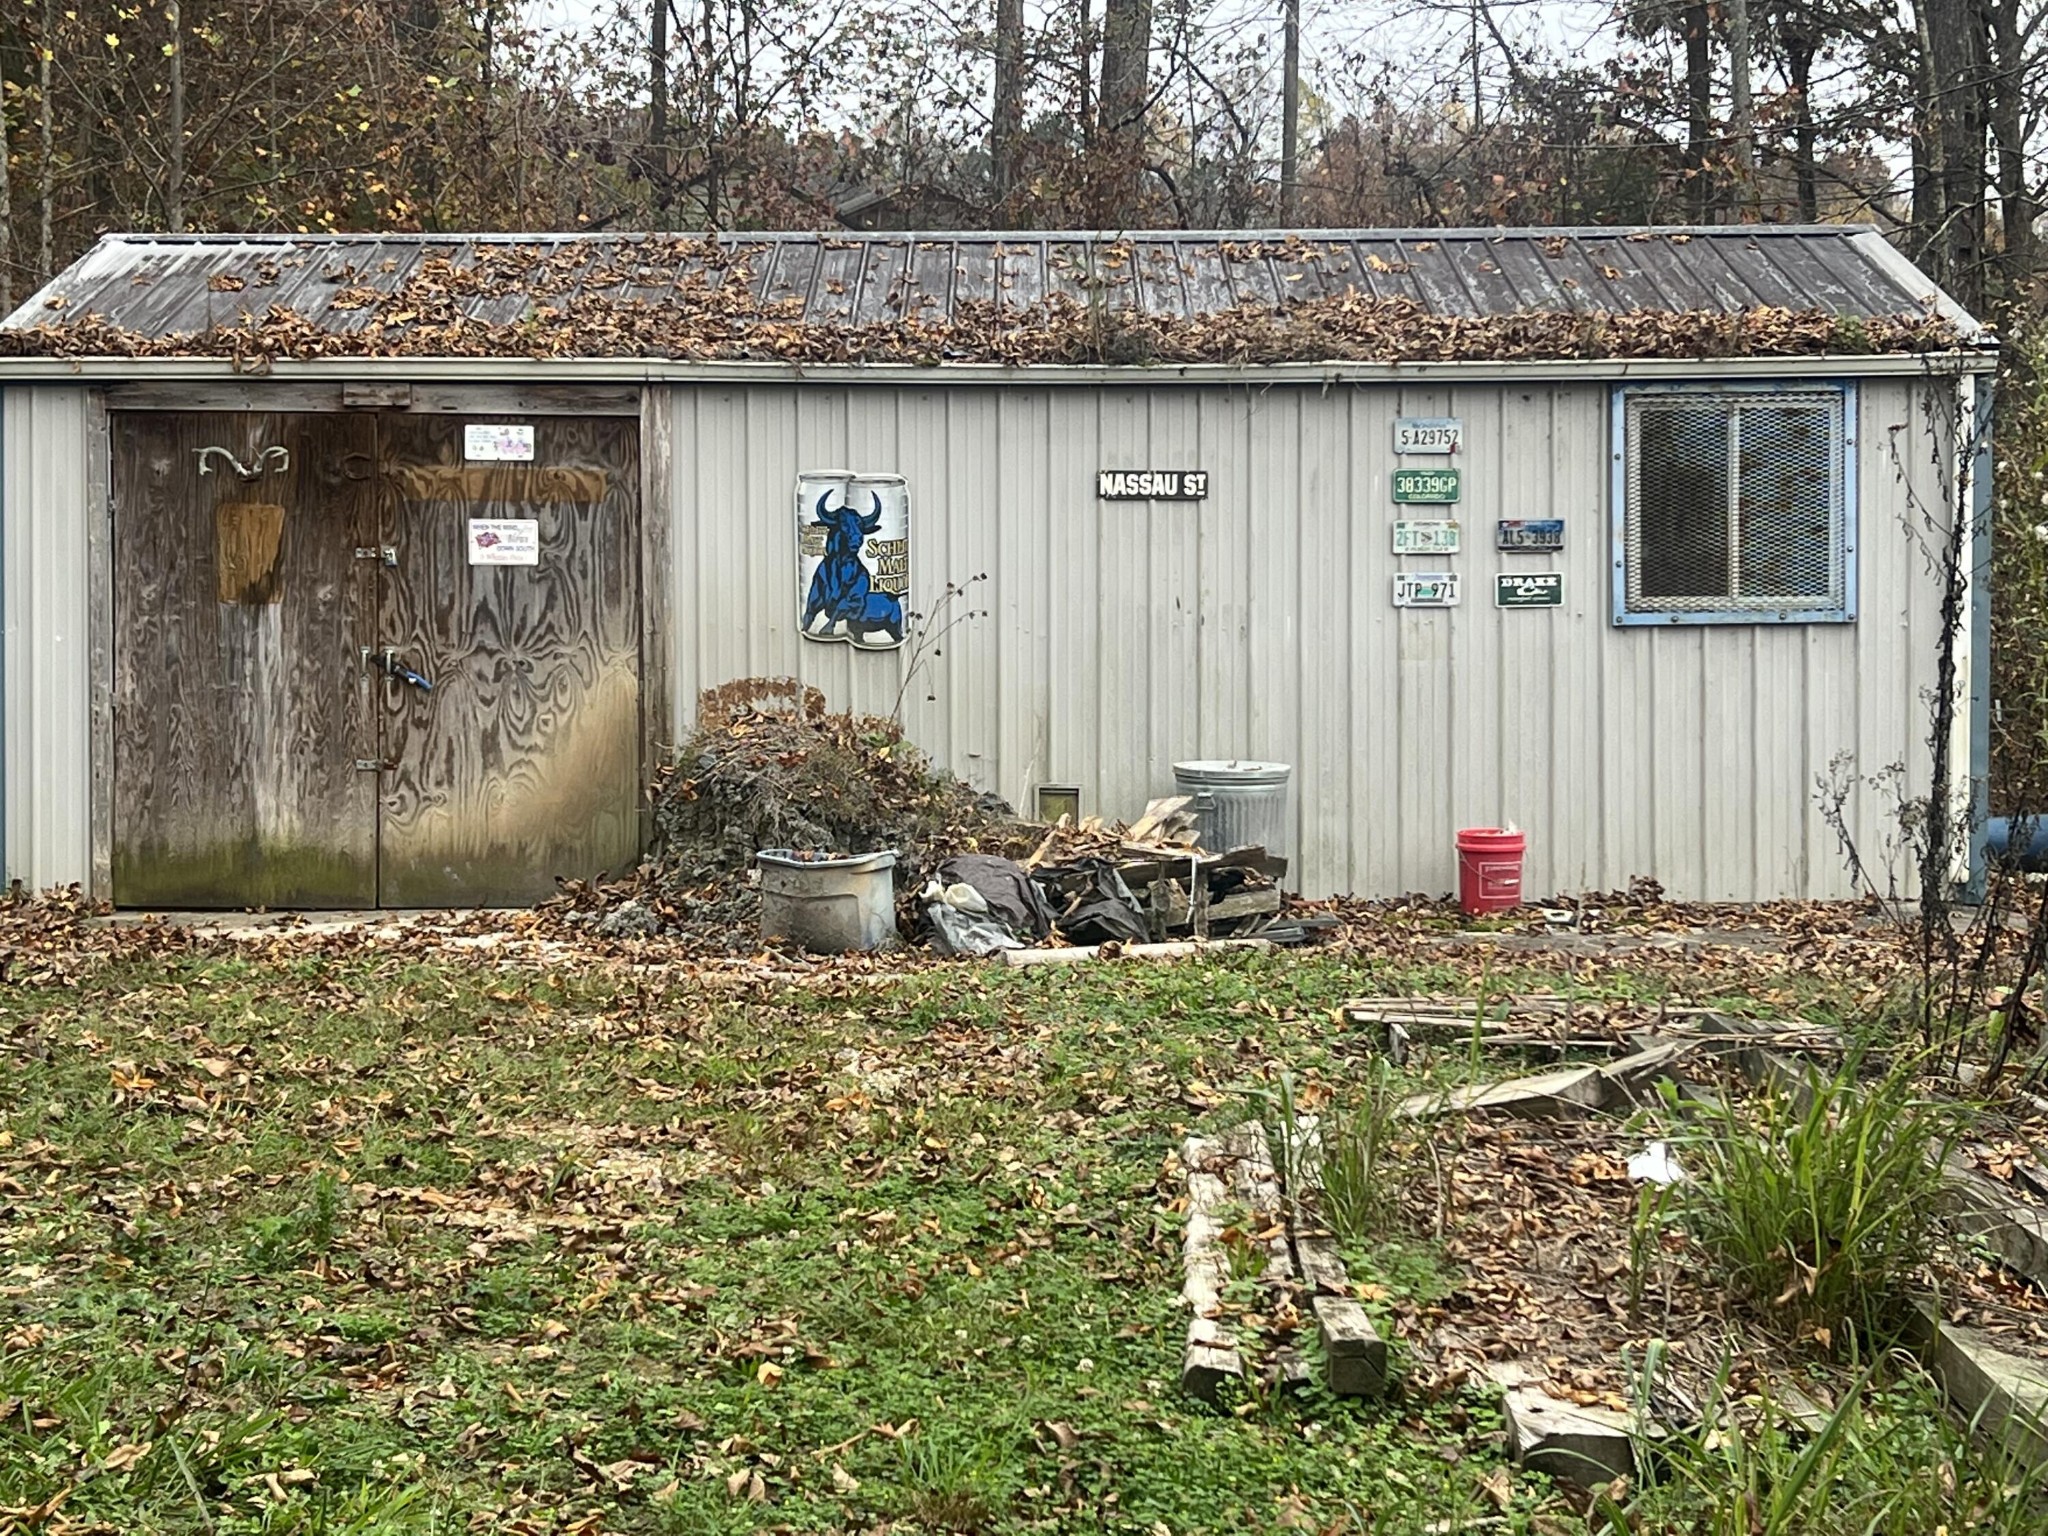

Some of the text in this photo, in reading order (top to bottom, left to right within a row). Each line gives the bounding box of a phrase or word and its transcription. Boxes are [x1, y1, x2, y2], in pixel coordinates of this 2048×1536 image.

[1099, 473, 1206, 496] NASSAU ST
[1396, 476, 1457, 493] 38339GP
[1431, 582, 1455, 598] 971
